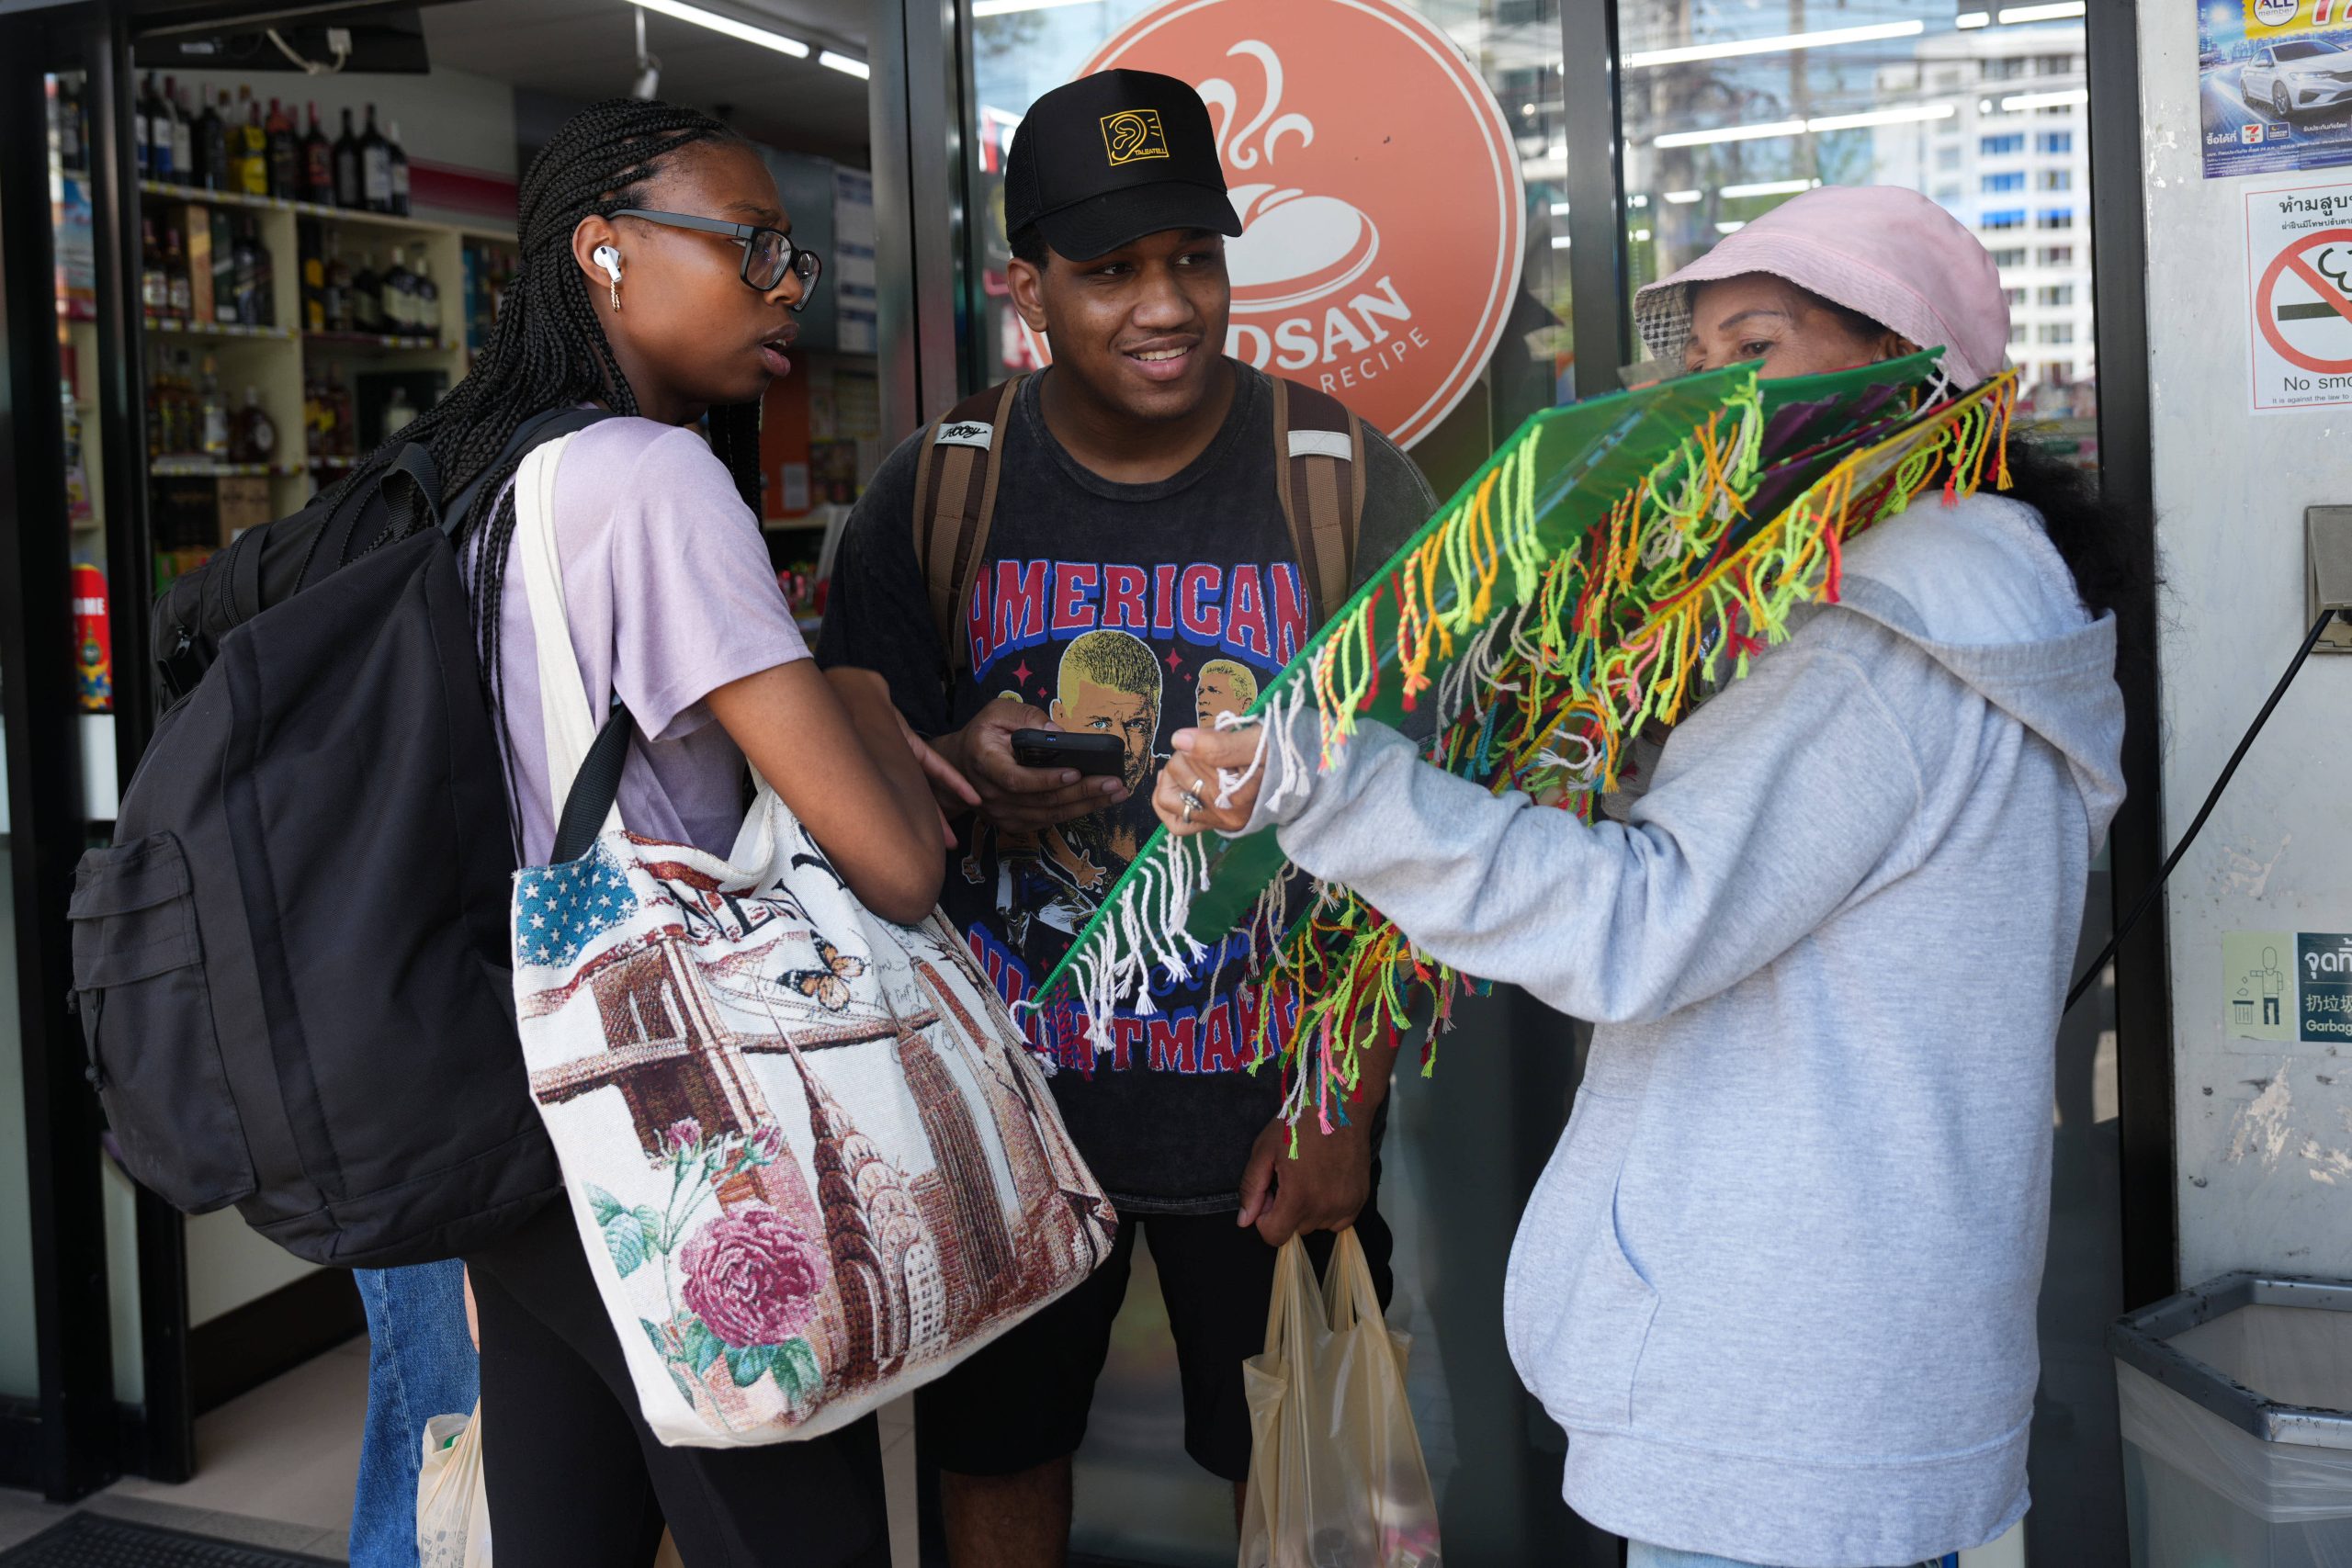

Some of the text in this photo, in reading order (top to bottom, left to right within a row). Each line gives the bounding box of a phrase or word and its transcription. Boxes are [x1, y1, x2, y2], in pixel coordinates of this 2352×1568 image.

[2258, 6, 2293, 17] member
[1319, 326, 1430, 393] RECIPE
[2284, 376, 2311, 391] No
[2287, 396, 2312, 404] against
[967, 558, 1309, 682] AMERICAN
[2306, 1019, 2352, 1036] Garbag
